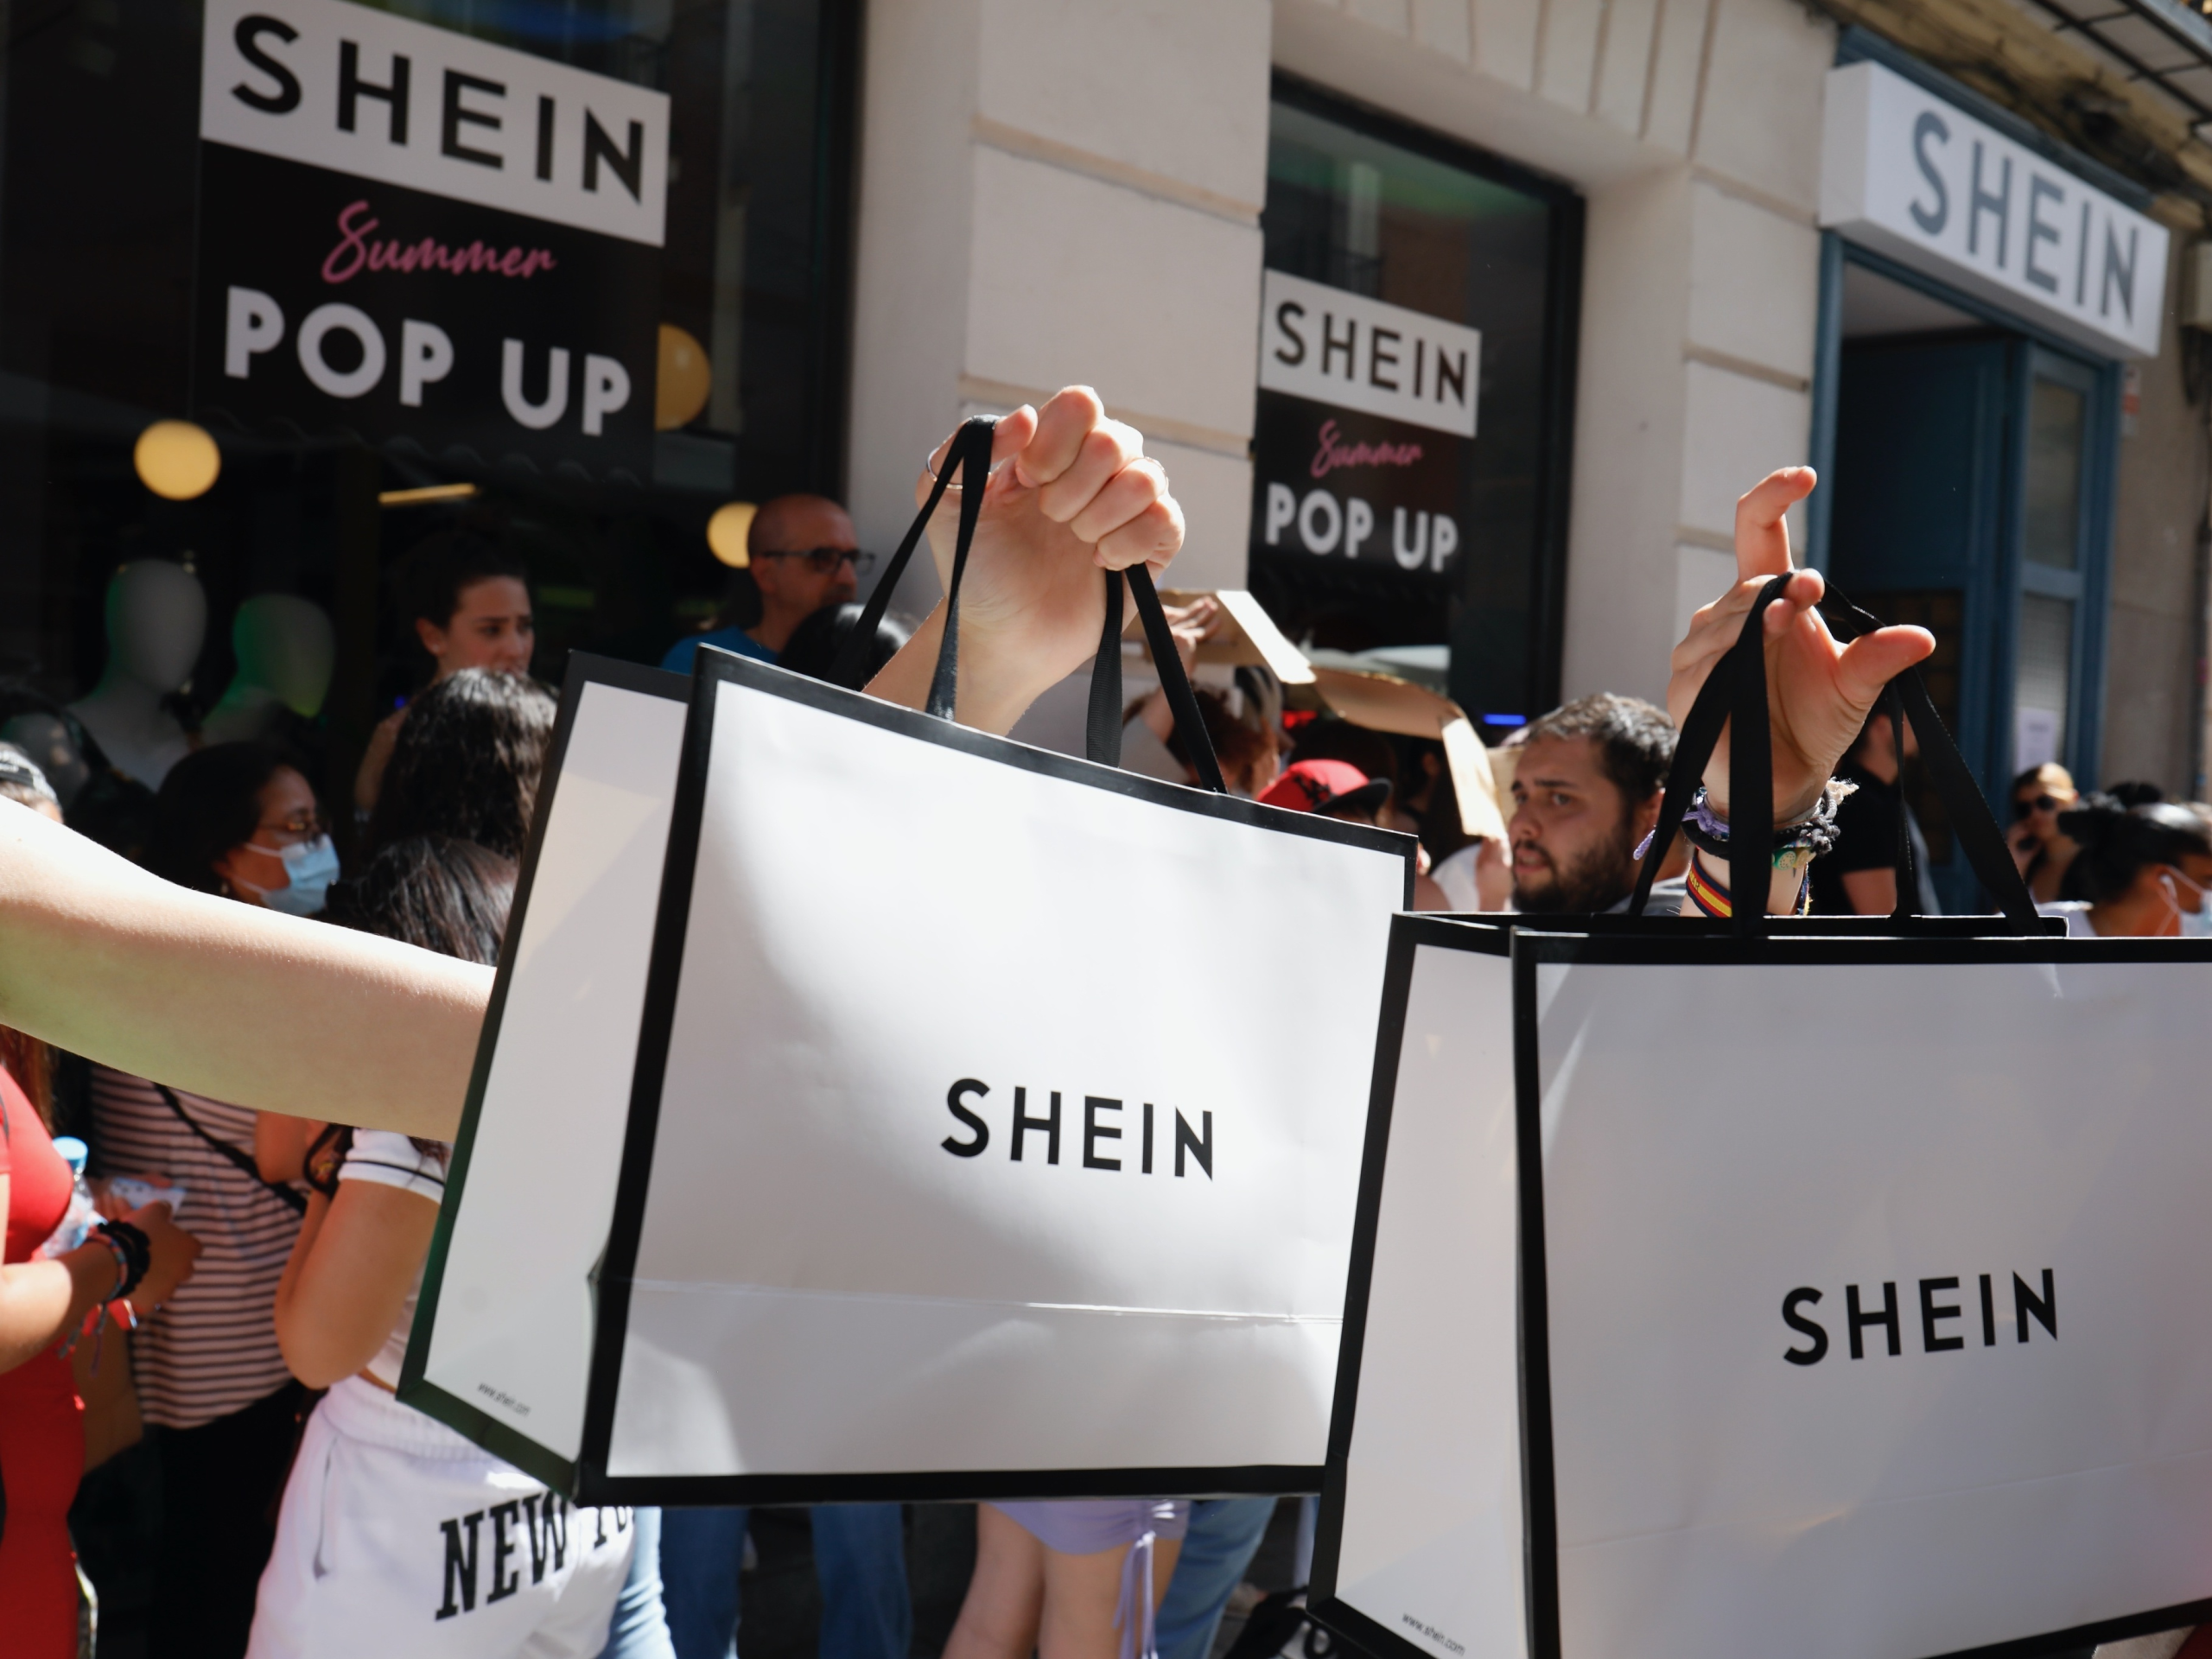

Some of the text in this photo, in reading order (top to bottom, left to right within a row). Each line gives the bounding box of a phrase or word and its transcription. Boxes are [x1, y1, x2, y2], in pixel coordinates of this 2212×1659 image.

[231, 14, 644, 206] SHEIN
[321, 200, 557, 284] Summer
[1909, 110, 2139, 327] SHEIN
[225, 285, 632, 437] POP UP
[1274, 299, 1468, 409] SHEIN
[1310, 418, 1425, 479] Summer
[1265, 481, 1459, 573] POP UP
[940, 1077, 1214, 1182] SHEIN
[1781, 1268, 2058, 1367] SHEIN
[435, 1490, 569, 1621] NEW
[1402, 1612, 1466, 1656] www.shein.com
